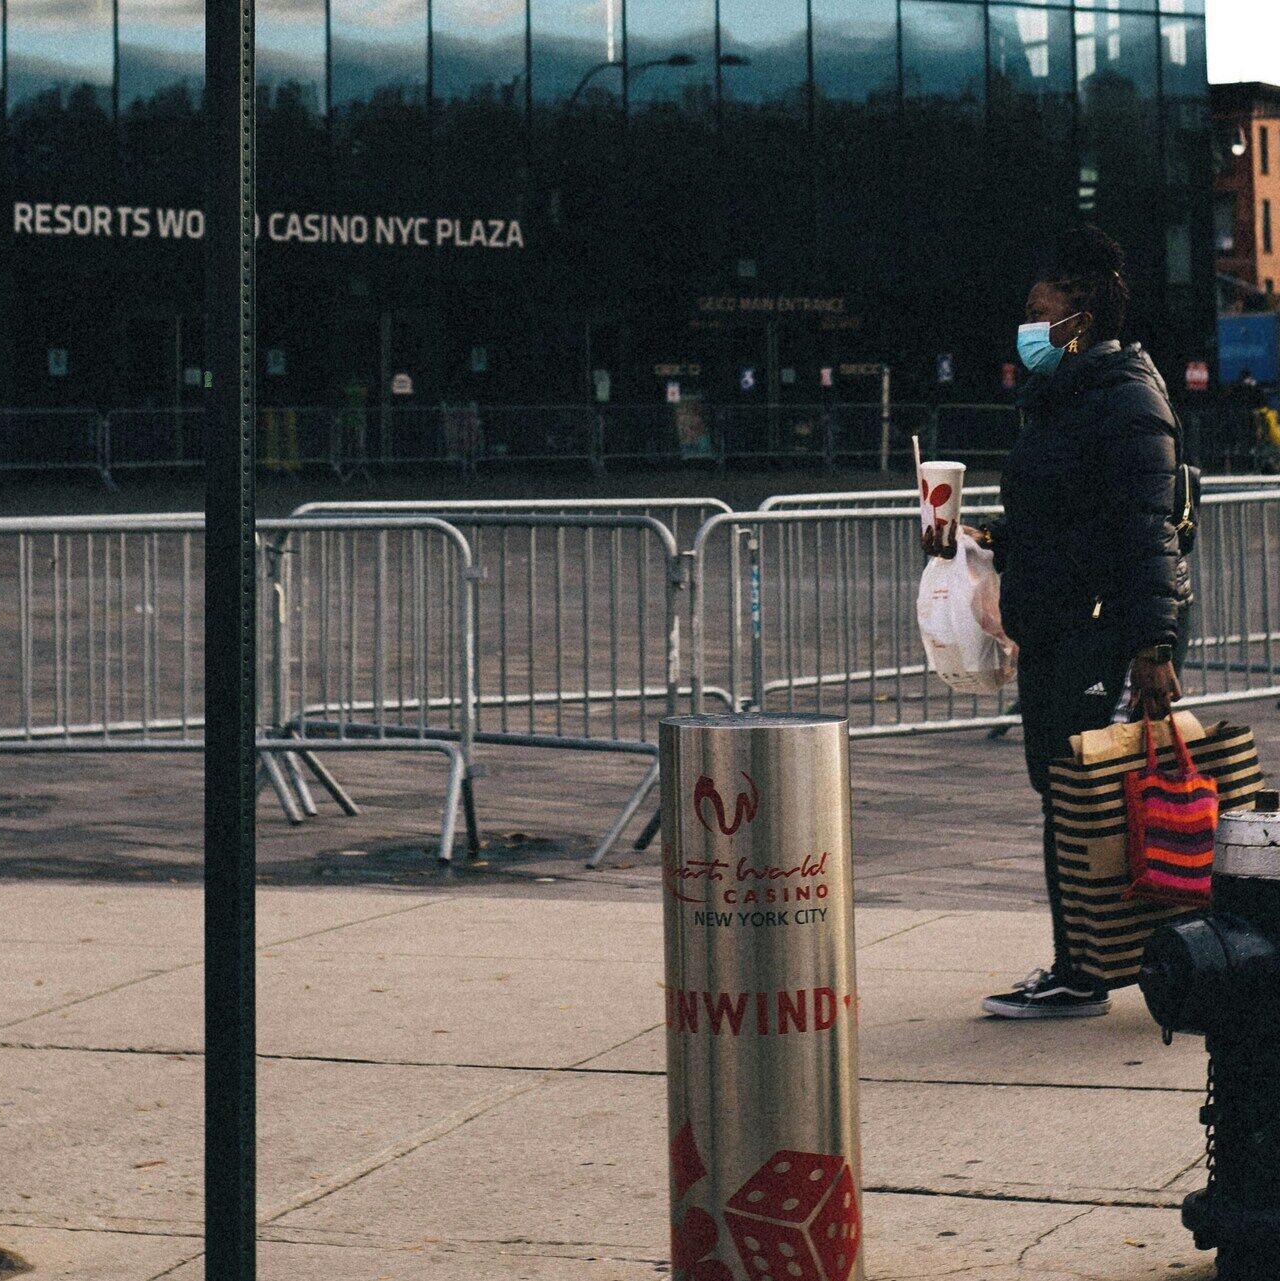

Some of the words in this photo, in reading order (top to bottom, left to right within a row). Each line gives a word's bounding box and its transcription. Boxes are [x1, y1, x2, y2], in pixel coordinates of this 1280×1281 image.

[13, 203, 150, 239] RESORTS
[268, 212, 369, 245] CASINO
[374, 217, 429, 248] NYC
[436, 219, 525, 248] PLAZA
[723, 884, 829, 904] CASINO
[694, 911, 733, 927] NEW
[737, 911, 789, 927] YORK
[794, 908, 828, 925] CITY
